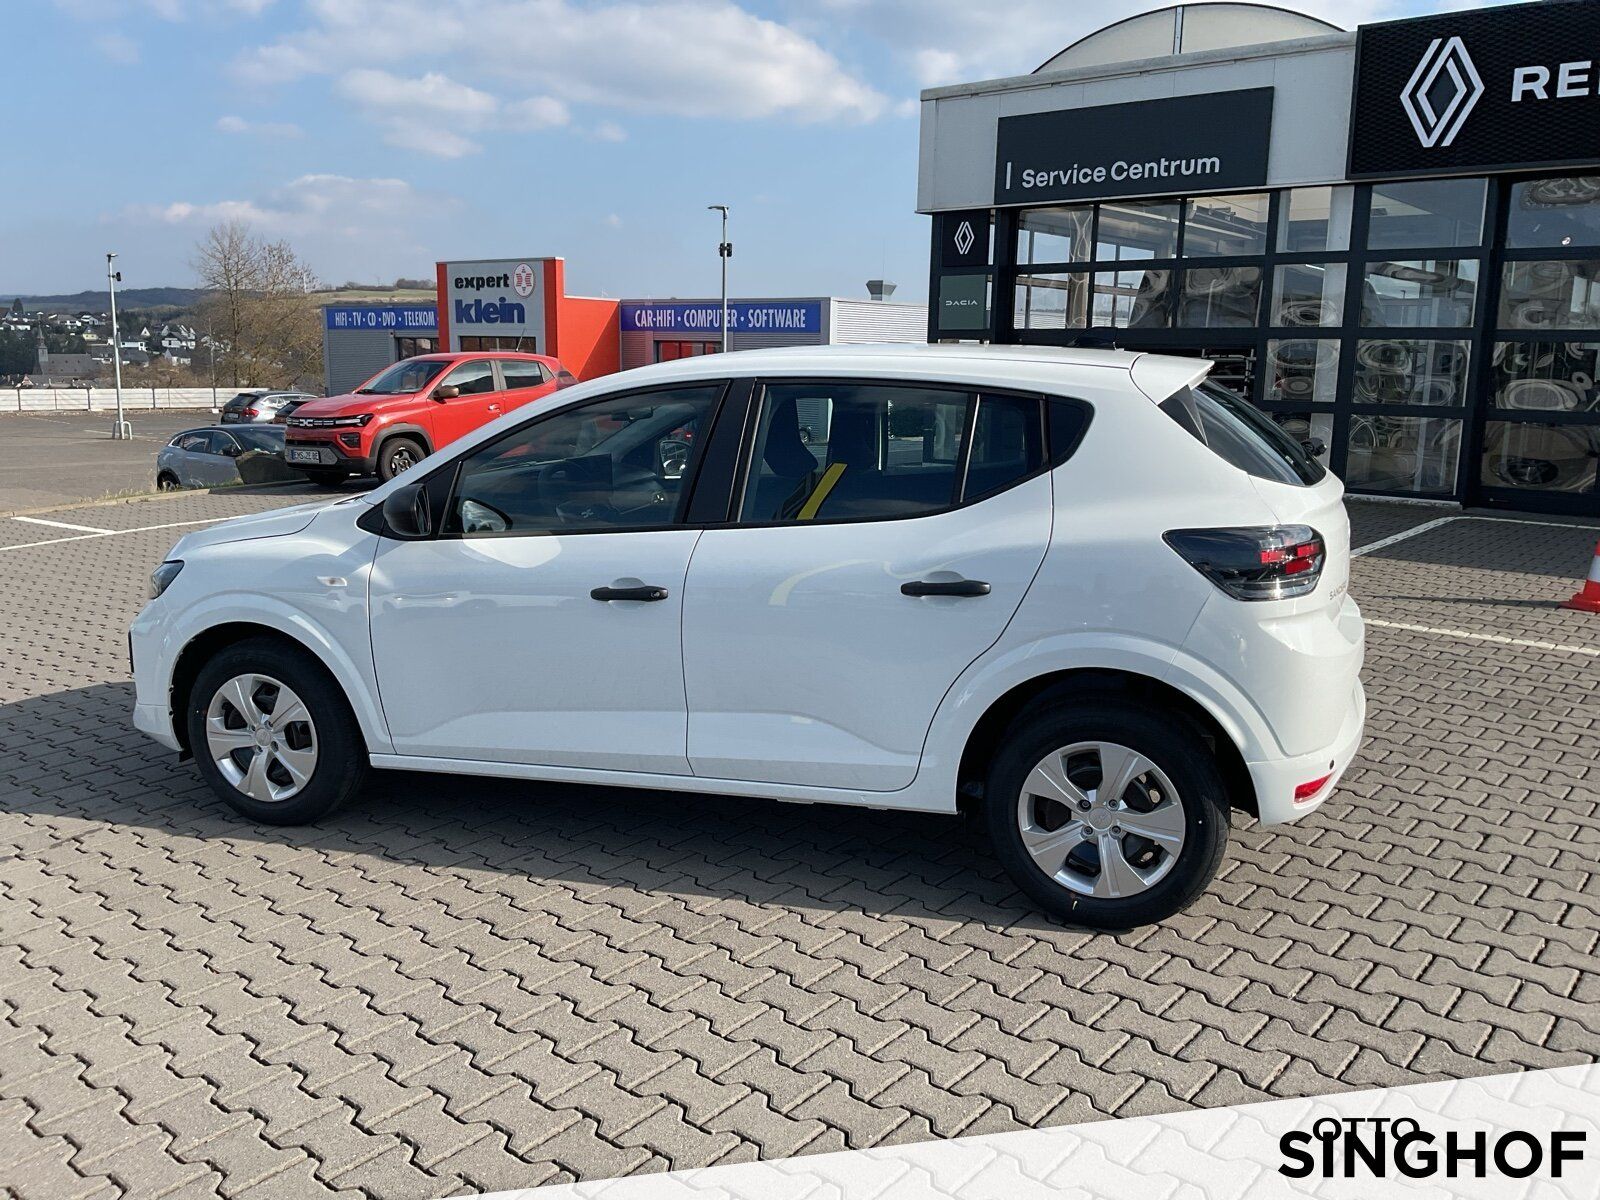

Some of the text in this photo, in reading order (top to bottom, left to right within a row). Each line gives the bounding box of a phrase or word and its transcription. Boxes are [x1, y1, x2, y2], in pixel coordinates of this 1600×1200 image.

[1511, 60, 1600, 103] RE
[1021, 156, 1220, 188] Service Centrum
[454, 273, 510, 291] expert
[335, 311, 436, 326] HIFI TV CD DVD TELEKOM
[454, 296, 526, 324] klein
[635, 309, 675, 328] CAR-HIFI
[748, 308, 806, 328] SOFTWARE
